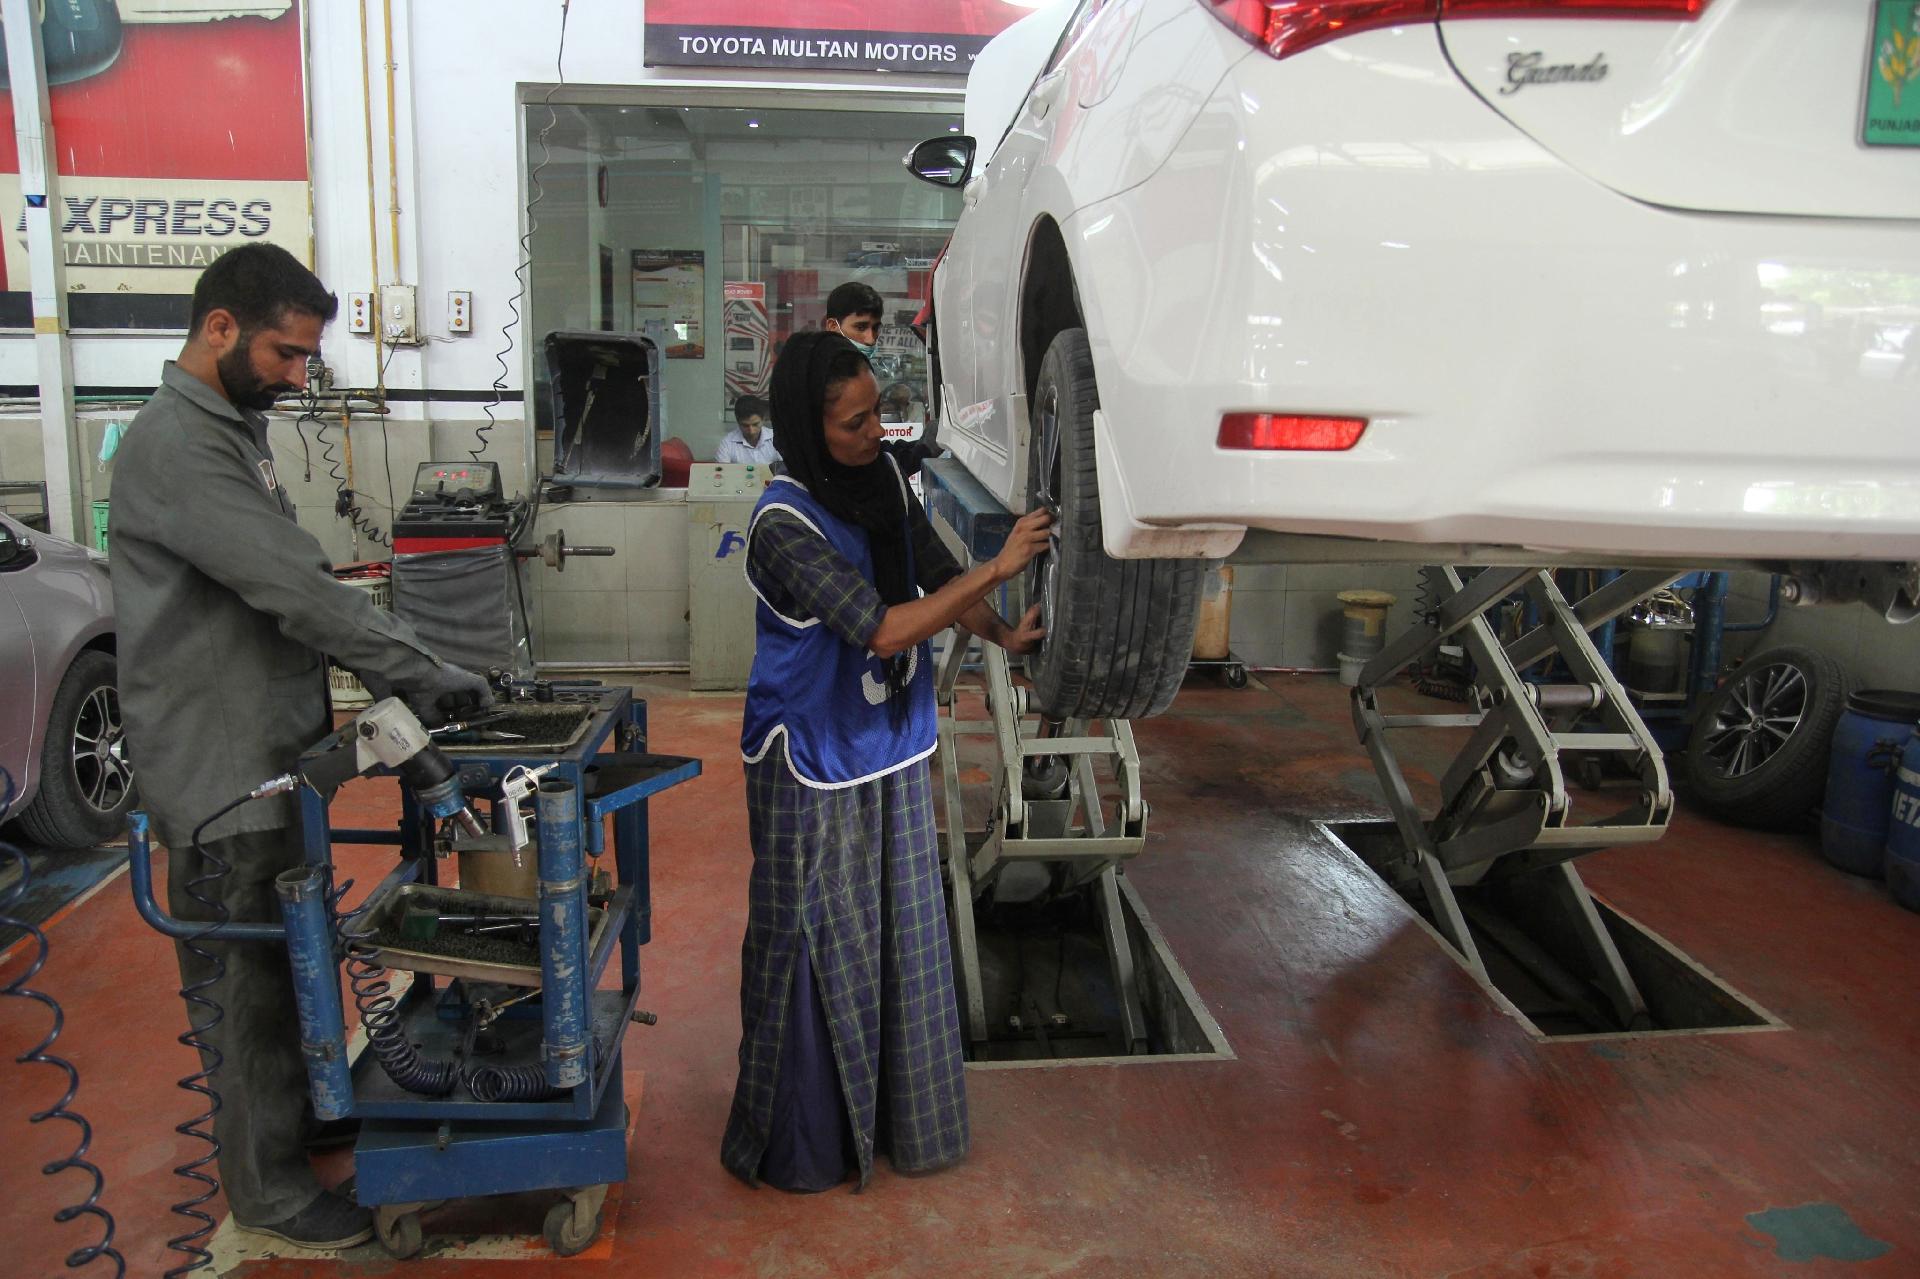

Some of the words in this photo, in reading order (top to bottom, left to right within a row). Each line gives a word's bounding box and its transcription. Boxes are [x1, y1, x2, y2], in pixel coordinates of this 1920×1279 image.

[678, 36, 766, 55] TOYOTA
[772, 38, 858, 59] MULTAN
[864, 42, 957, 62] MOTORS
[1498, 52, 1608, 95] Grande
